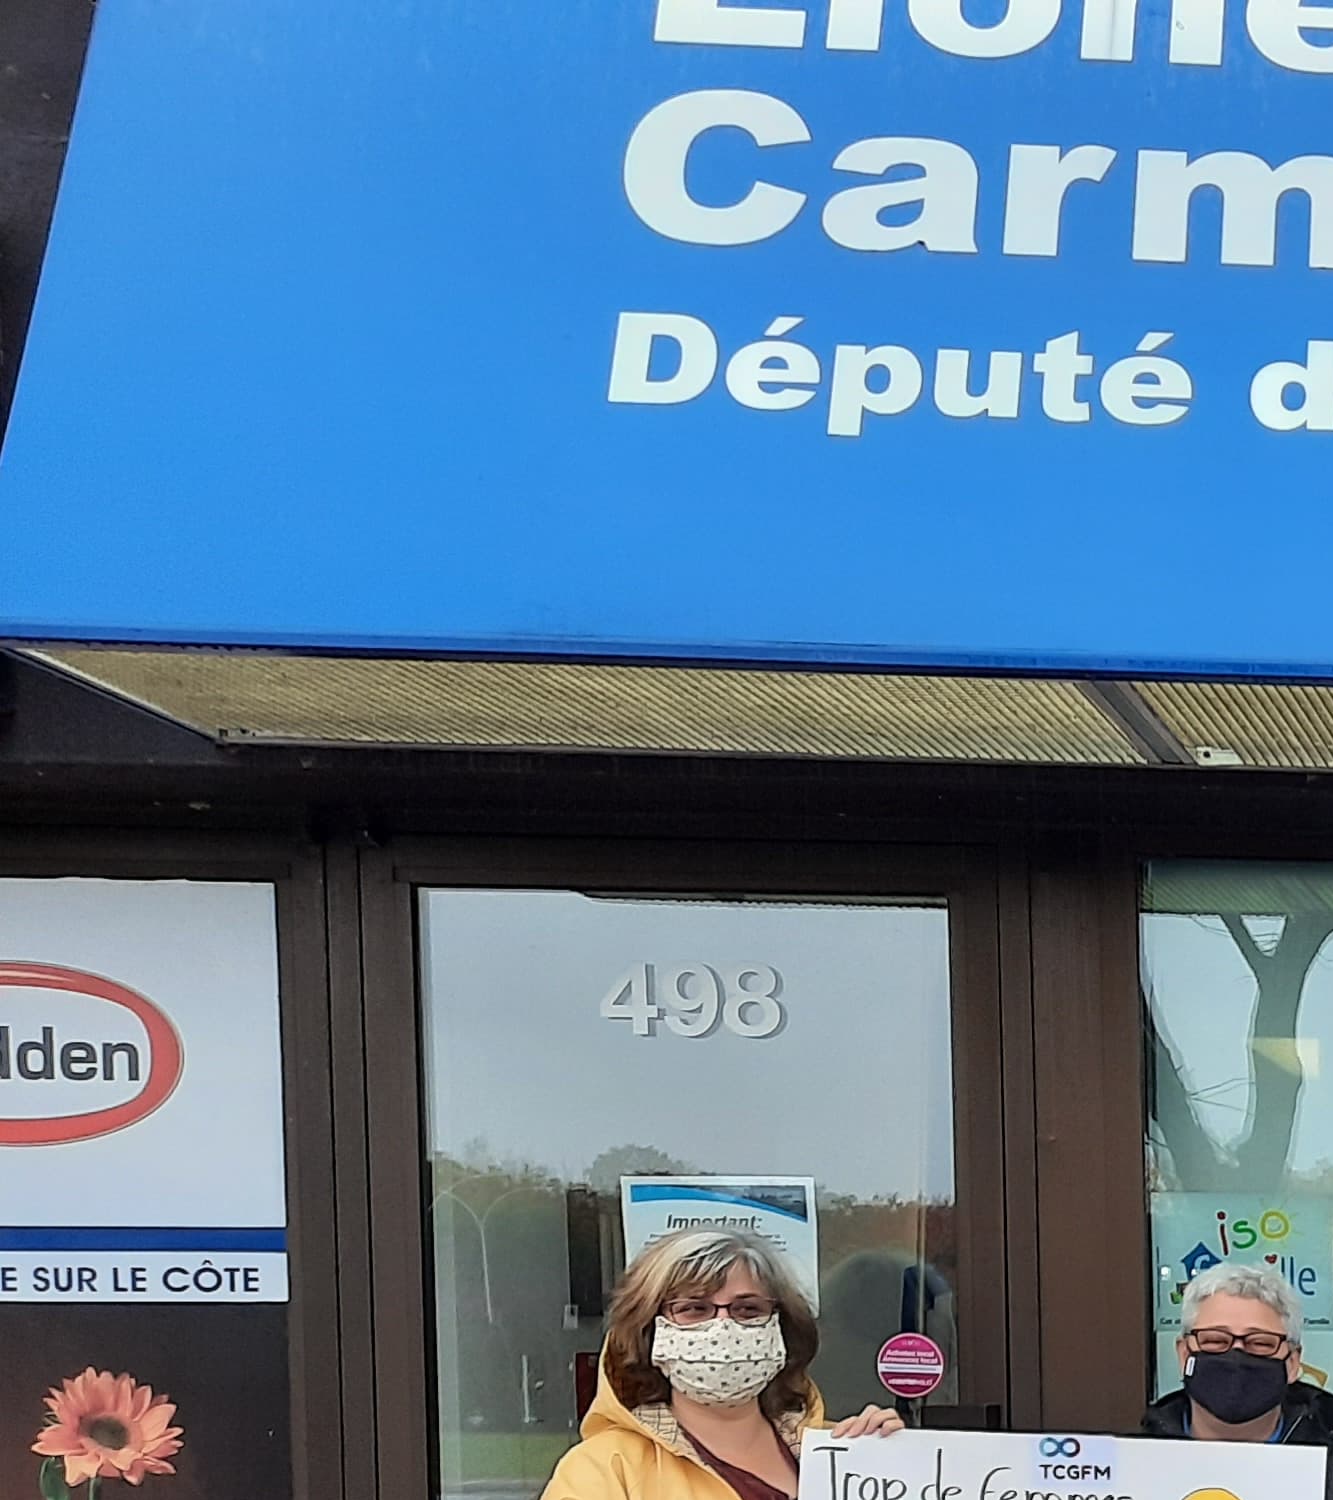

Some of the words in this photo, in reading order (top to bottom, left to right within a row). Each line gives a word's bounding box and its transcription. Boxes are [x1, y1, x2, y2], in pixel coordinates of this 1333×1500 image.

[606, 312, 1194, 437] Député
[601, 963, 785, 1039] 498
[0, 1026, 140, 1081] den
[33, 1266, 97, 1292] SUR
[113, 1267, 147, 1292] LE
[162, 1259, 260, 1293] CÔTE
[1039, 1465, 1111, 1481] TCGFM
